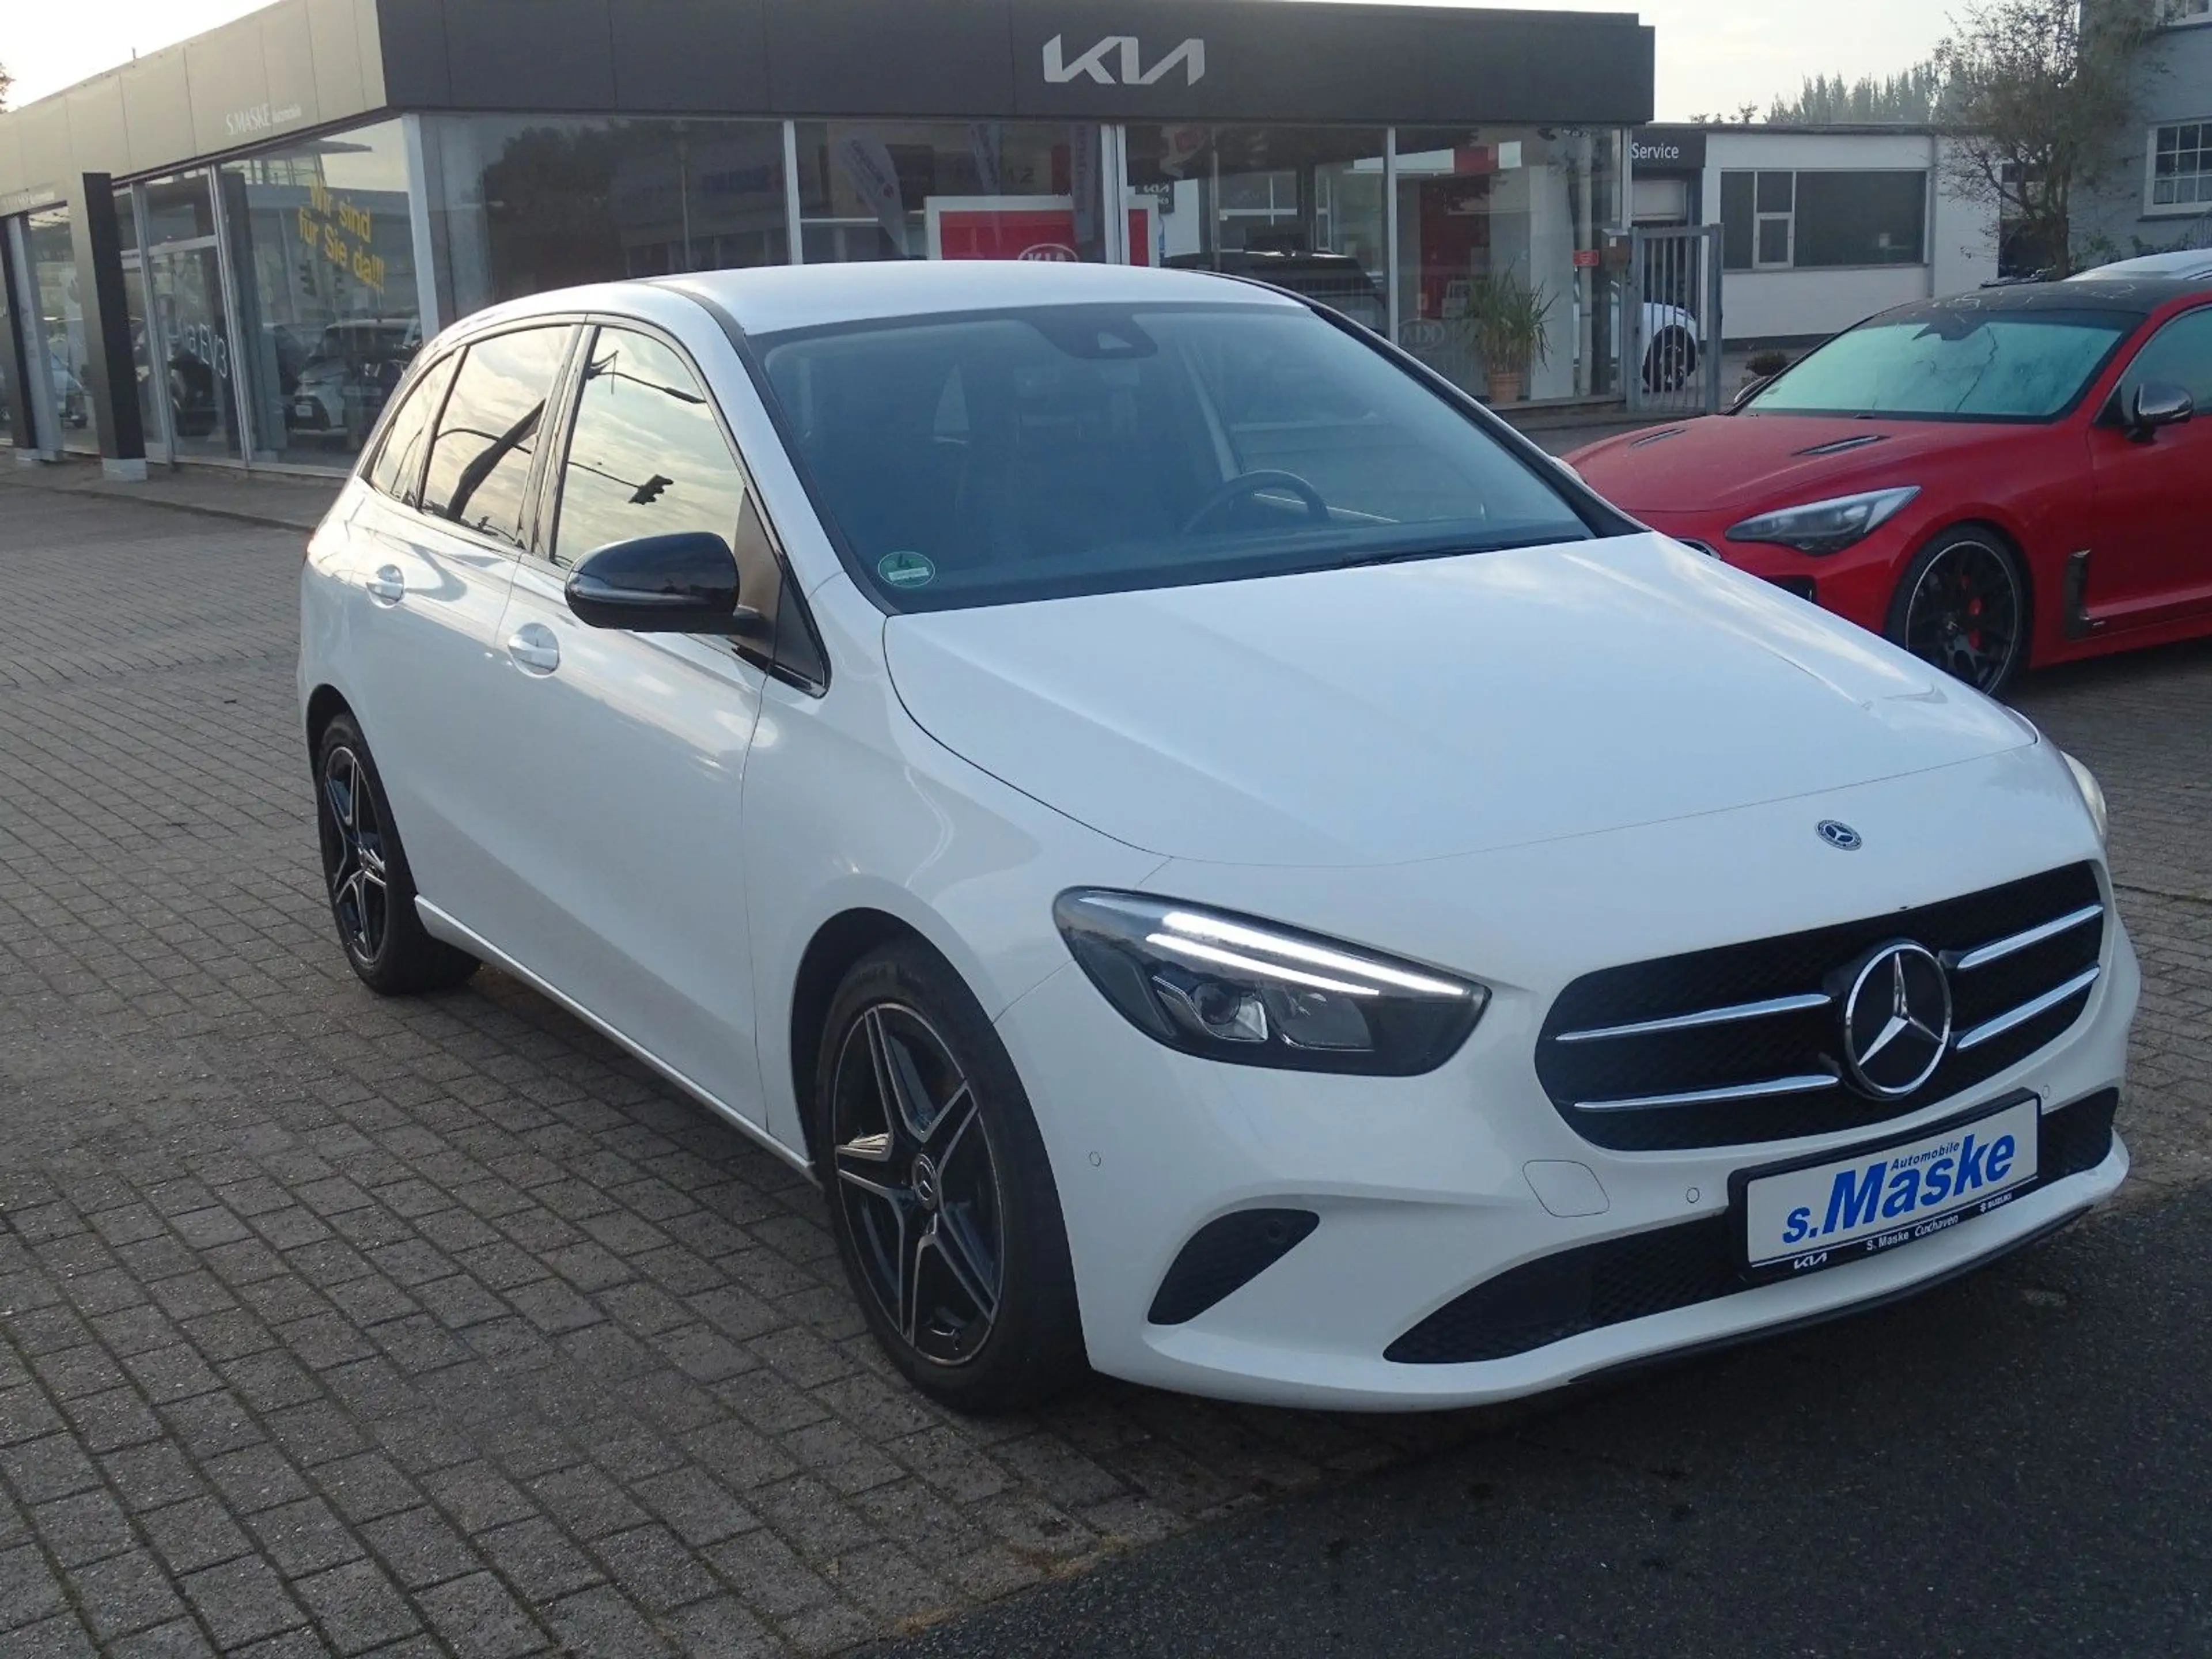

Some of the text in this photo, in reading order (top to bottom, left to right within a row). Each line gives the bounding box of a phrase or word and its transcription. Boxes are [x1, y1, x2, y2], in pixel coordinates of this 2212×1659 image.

[1043, 33, 1205, 86] KIA
[1631, 142, 1679, 159] Service
[338, 196, 372, 244] sind
[324, 222, 347, 267] Sie
[1890, 1141, 1960, 1172] Automobile
[1878, 1231, 1910, 1248] Maske
[1915, 1215, 1959, 1237] Cuxhaven
[1794, 1252, 1827, 1270] KIA
